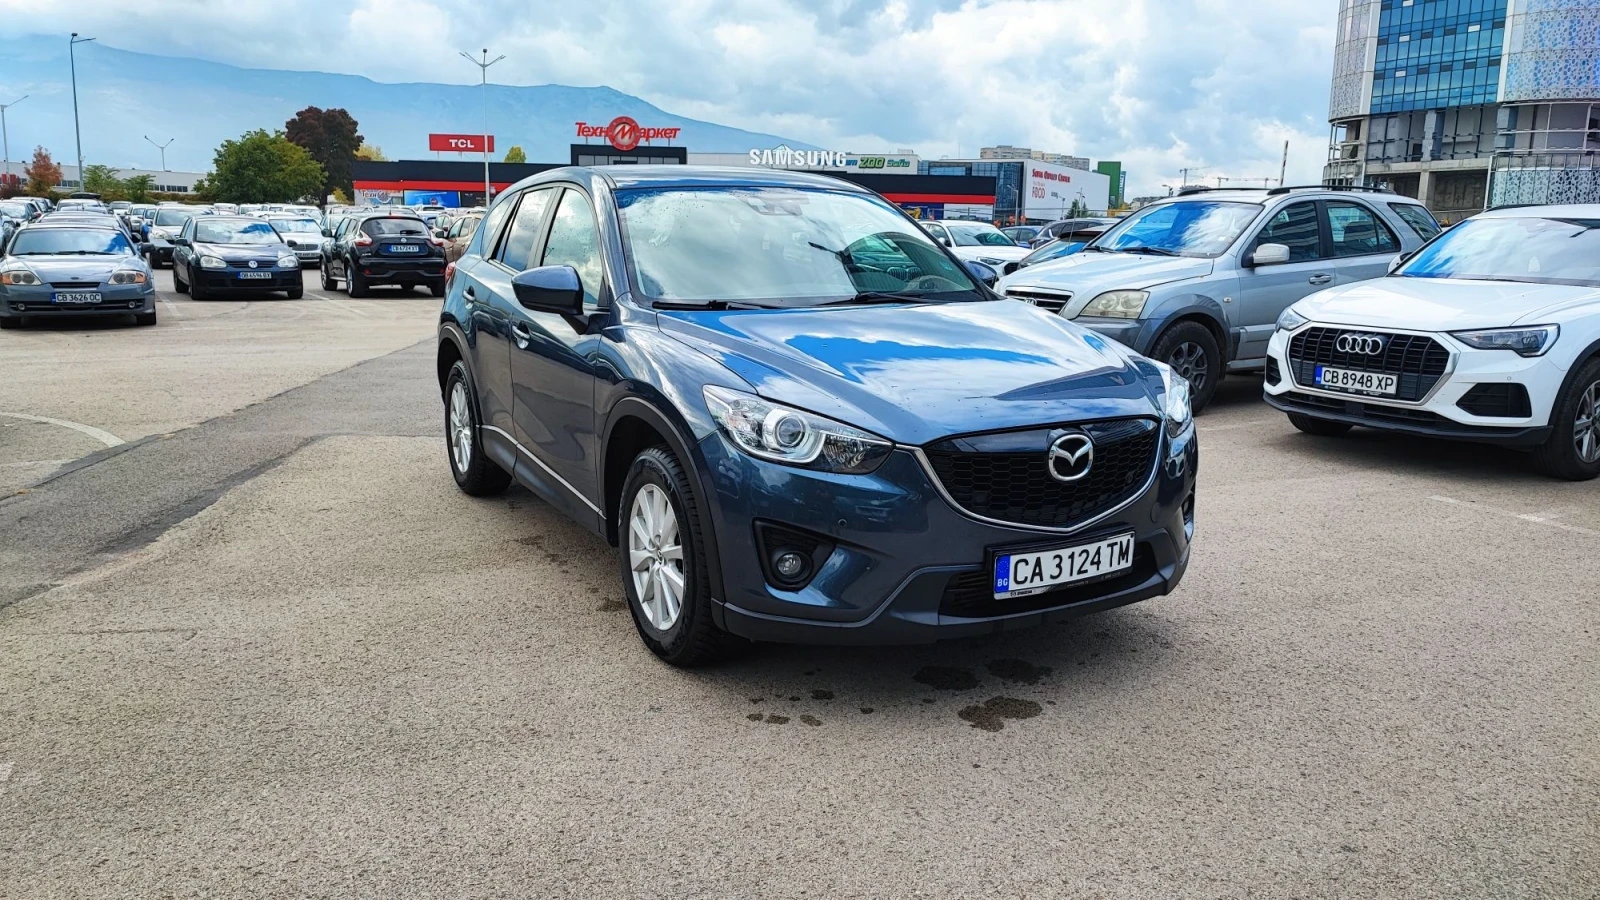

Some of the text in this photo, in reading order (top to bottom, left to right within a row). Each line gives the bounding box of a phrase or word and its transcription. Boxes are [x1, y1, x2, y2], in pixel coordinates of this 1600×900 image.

[449, 139, 474, 148] TCL
[749, 148, 846, 167] SAMSUNG
[859, 157, 885, 169] ZOO
[1323, 370, 1394, 390] CB 8948 XP
[1013, 539, 1131, 585] CA 3124 TM
[997, 578, 1008, 587] BG
